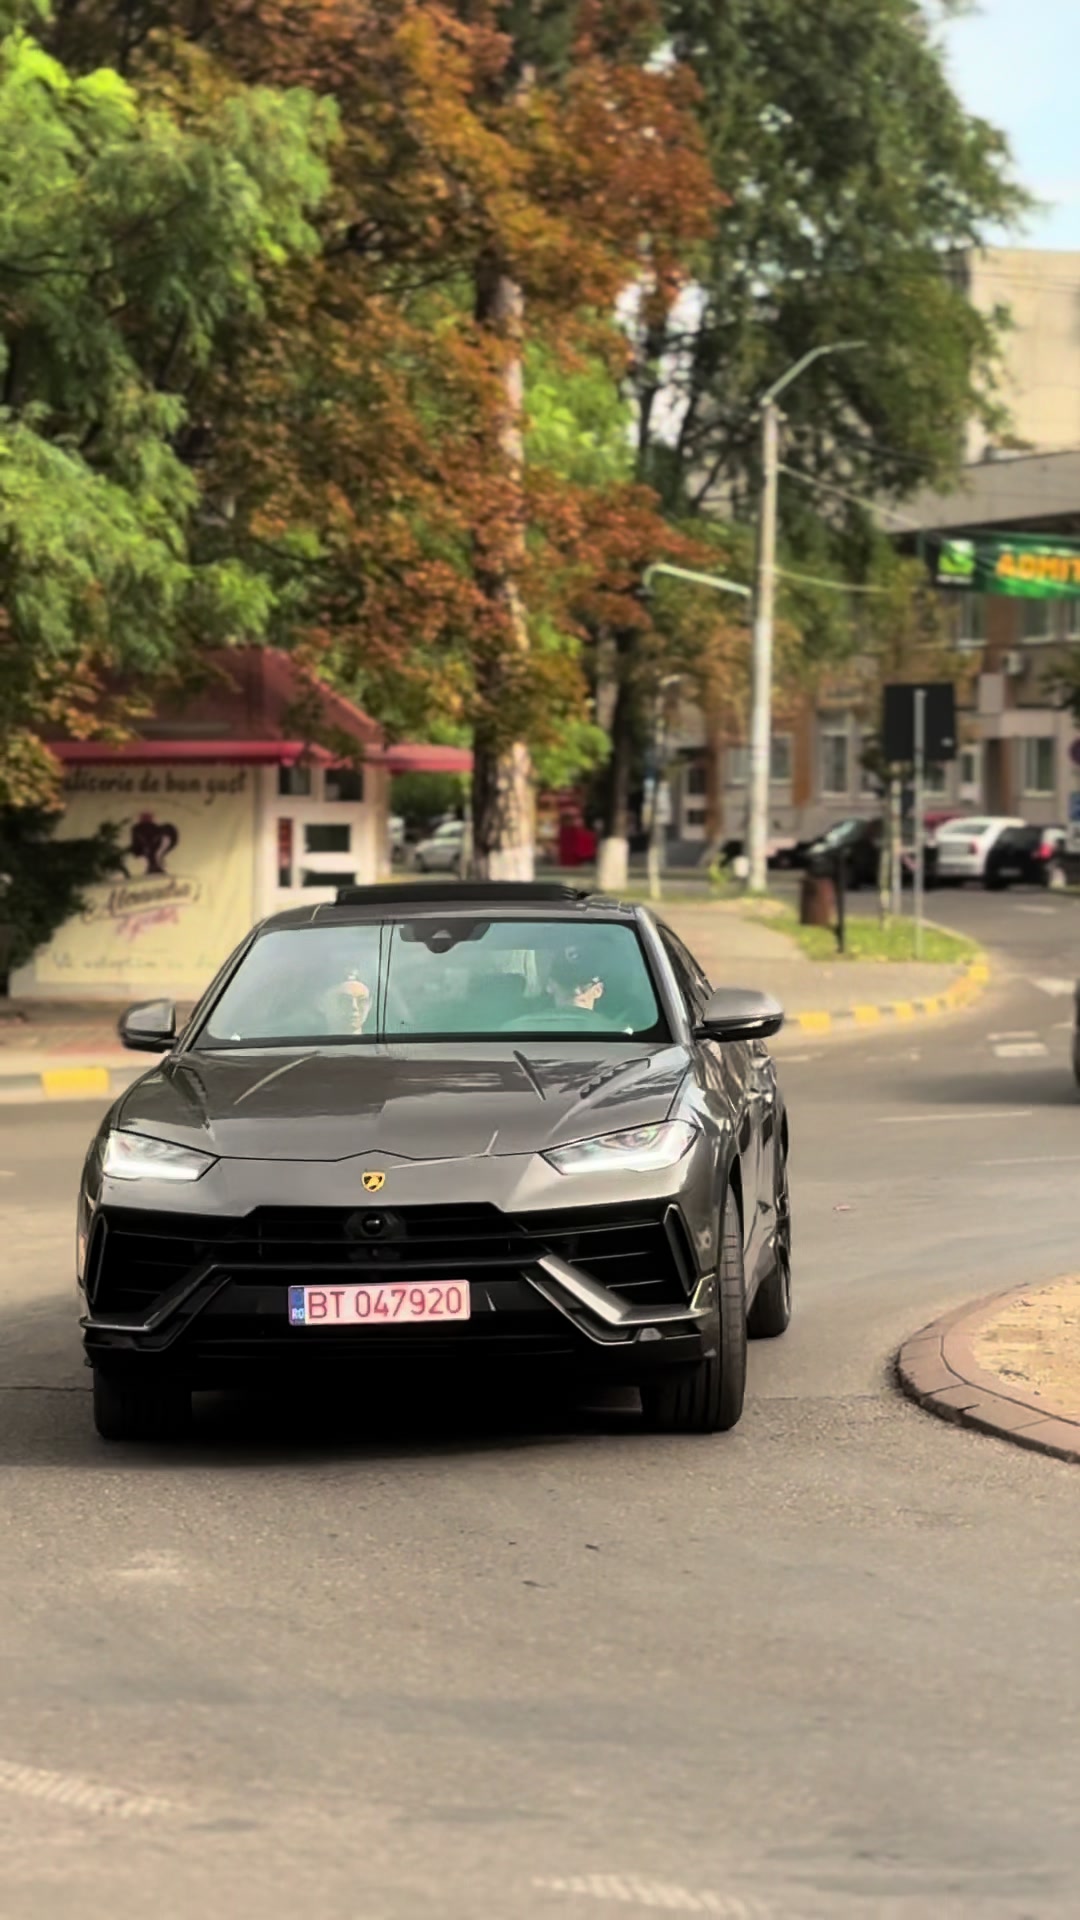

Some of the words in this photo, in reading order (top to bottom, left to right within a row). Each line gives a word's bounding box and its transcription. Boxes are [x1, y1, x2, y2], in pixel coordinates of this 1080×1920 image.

[307, 1291, 345, 1319] BT
[355, 1286, 462, 1318] 047920
[291, 1308, 304, 1320] RO
